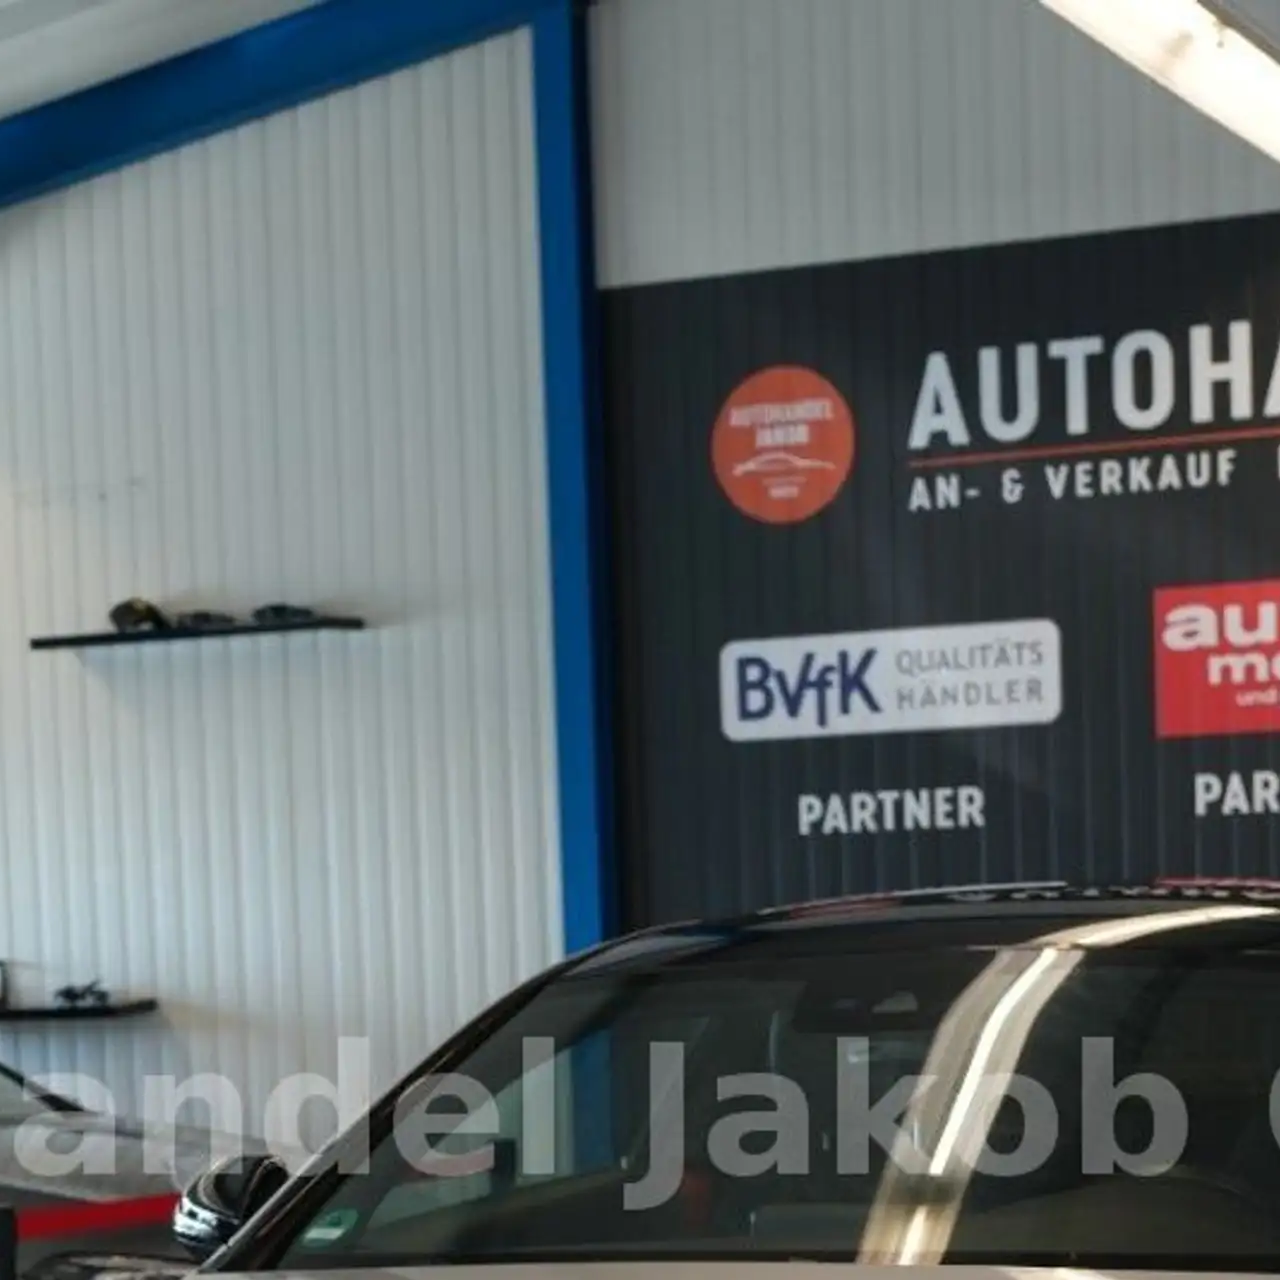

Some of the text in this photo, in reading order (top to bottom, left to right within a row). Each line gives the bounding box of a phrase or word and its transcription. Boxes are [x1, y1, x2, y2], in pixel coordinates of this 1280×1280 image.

[908, 475, 981, 512] AN-
[1001, 467, 1024, 504] &
[1045, 450, 1237, 501] VERKAUF
[896, 638, 1045, 678] QUALITÄTS
[736, 647, 883, 726] BVfK
[896, 675, 1044, 713] HÄNDLER
[1235, 688, 1277, 708] und
[797, 786, 986, 836] PARTNER
